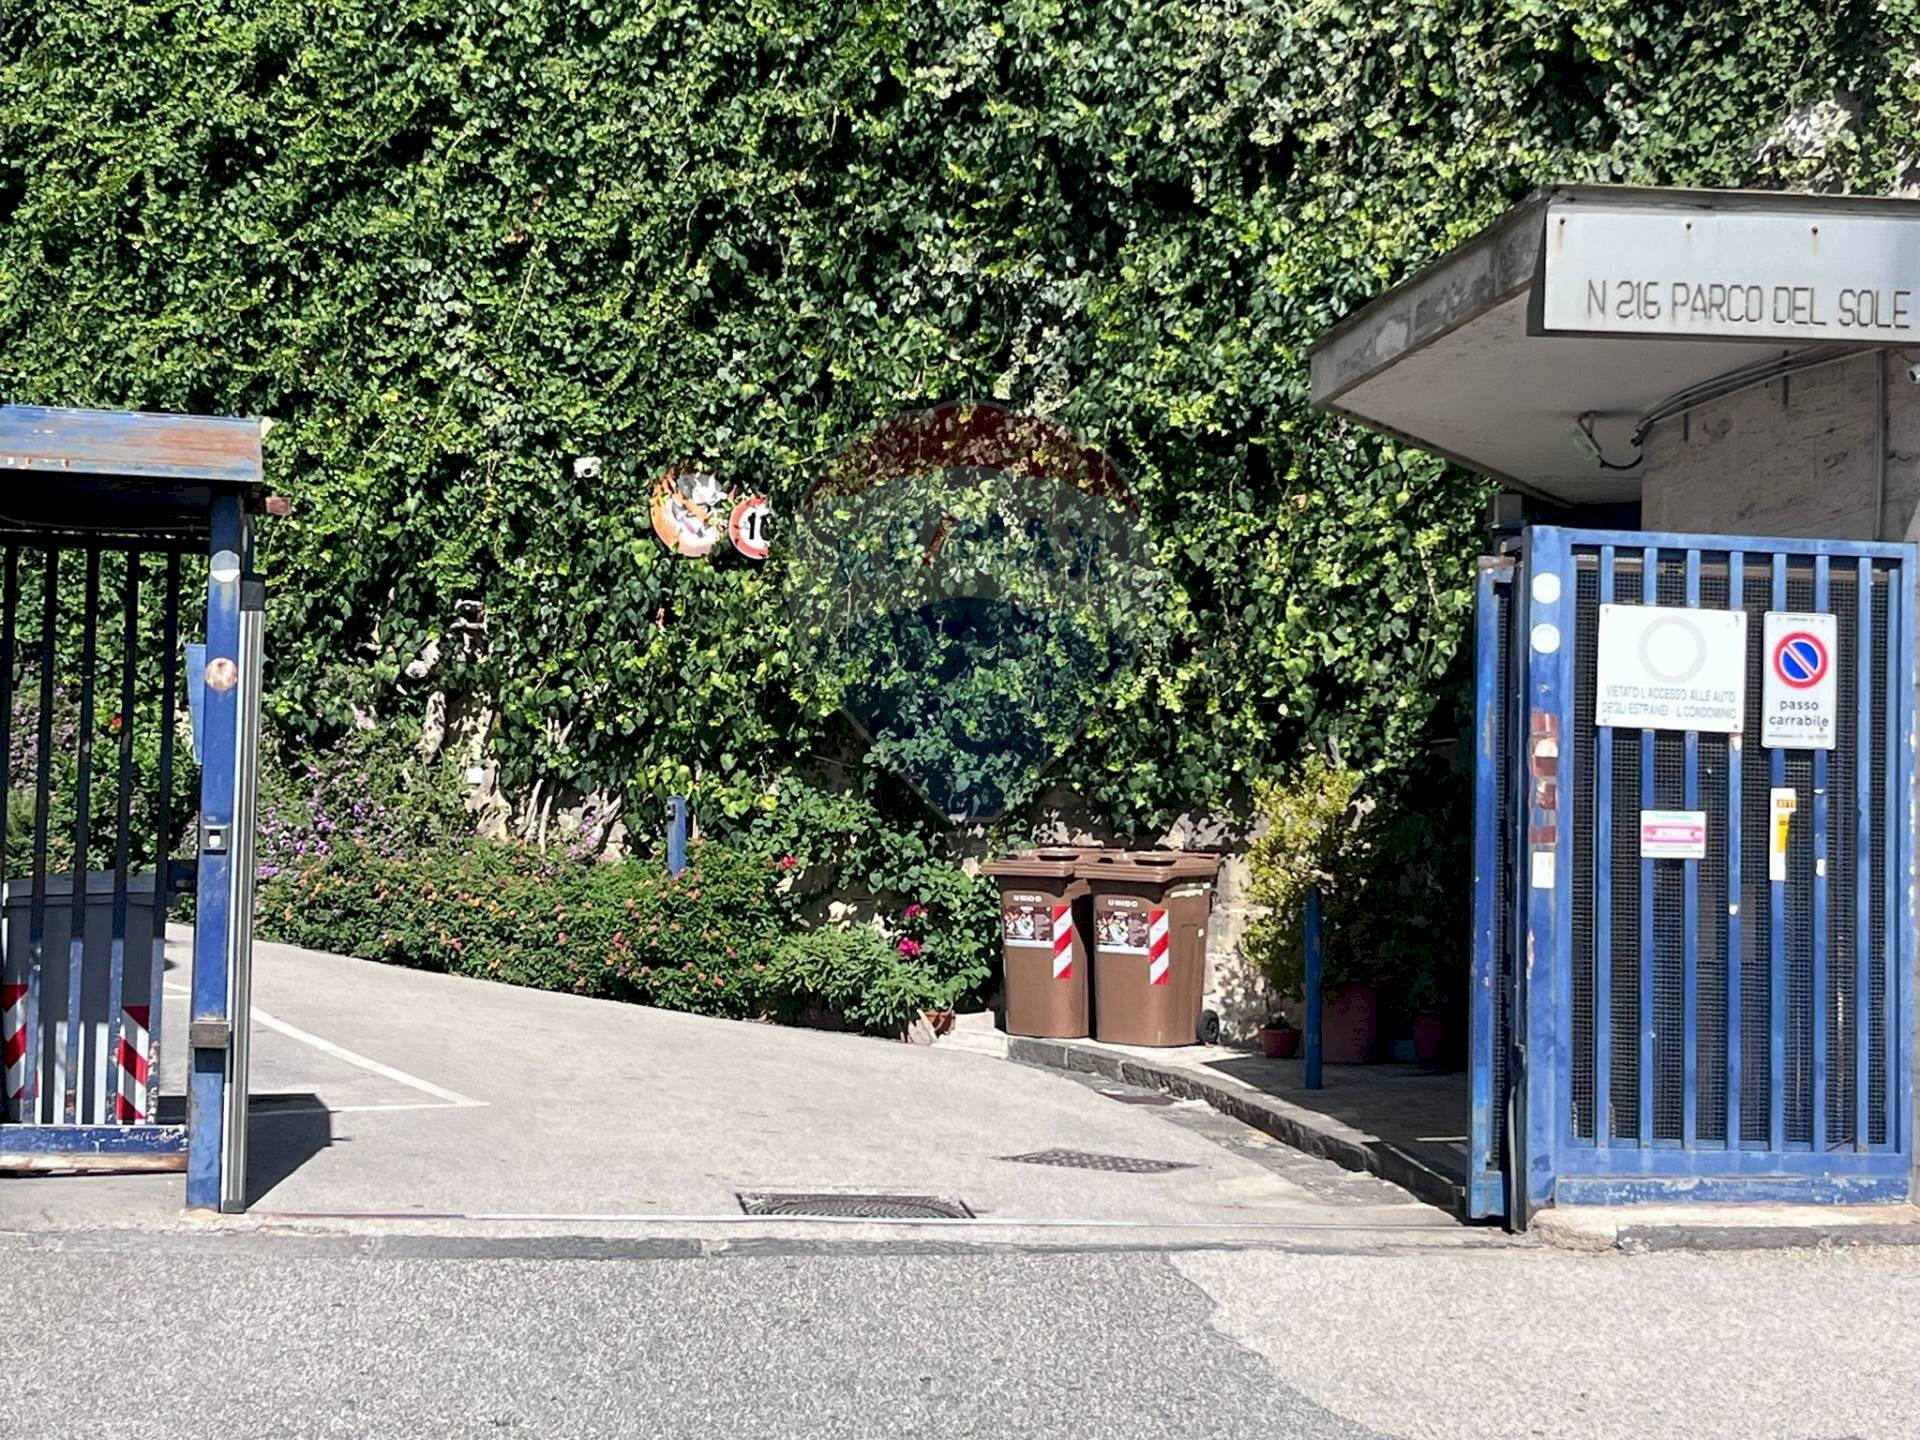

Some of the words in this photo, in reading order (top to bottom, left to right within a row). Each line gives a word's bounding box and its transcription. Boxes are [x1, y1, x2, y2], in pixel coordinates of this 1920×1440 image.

[1587, 279, 1606, 318] N
[1616, 280, 1661, 320] 216
[1671, 281, 1764, 324] PARCO
[1773, 286, 1827, 327] DEL
[1838, 288, 1912, 330] SOLE
[1606, 685, 1639, 698] VIETATO
[1713, 690, 1736, 703] AUTO
[1780, 700, 1819, 712] passo
[1769, 714, 1829, 727] carrabile
